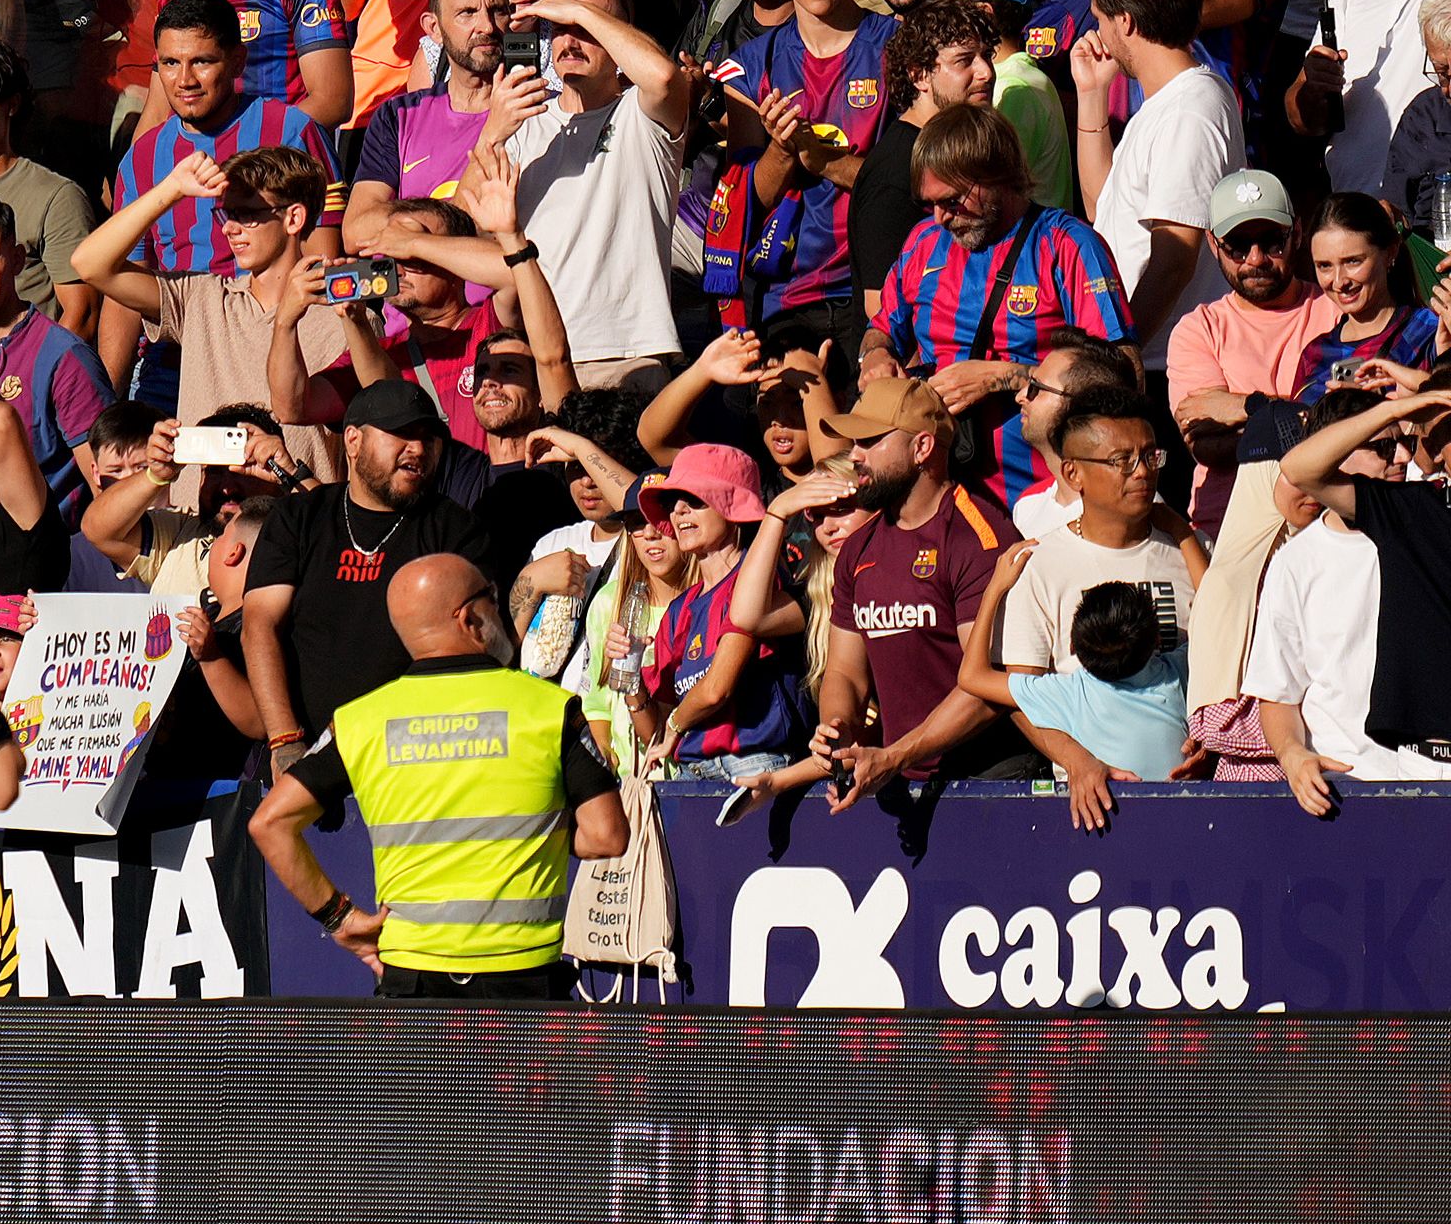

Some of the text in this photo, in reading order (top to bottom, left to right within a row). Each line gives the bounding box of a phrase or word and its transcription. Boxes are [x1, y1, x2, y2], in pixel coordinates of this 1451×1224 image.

[336, 565, 381, 583] miu
[44, 632, 136, 661] ¡HOY ES MI
[40, 658, 156, 694] CUMPLEAÑOS!
[66, 695, 83, 709] ME
[85, 691, 109, 708] HARÍA
[49, 709, 121, 731] MUCHA ILUSIÓN
[407, 715, 479, 735] GRUPO
[36, 733, 121, 751] QUE ME FIRMARAS
[390, 737, 504, 763] LEVANTINA
[28, 755, 114, 778] AMINE YAMAL
[939, 870, 1250, 1010] caixa
[611, 1122, 1073, 1224] FUNDACION
